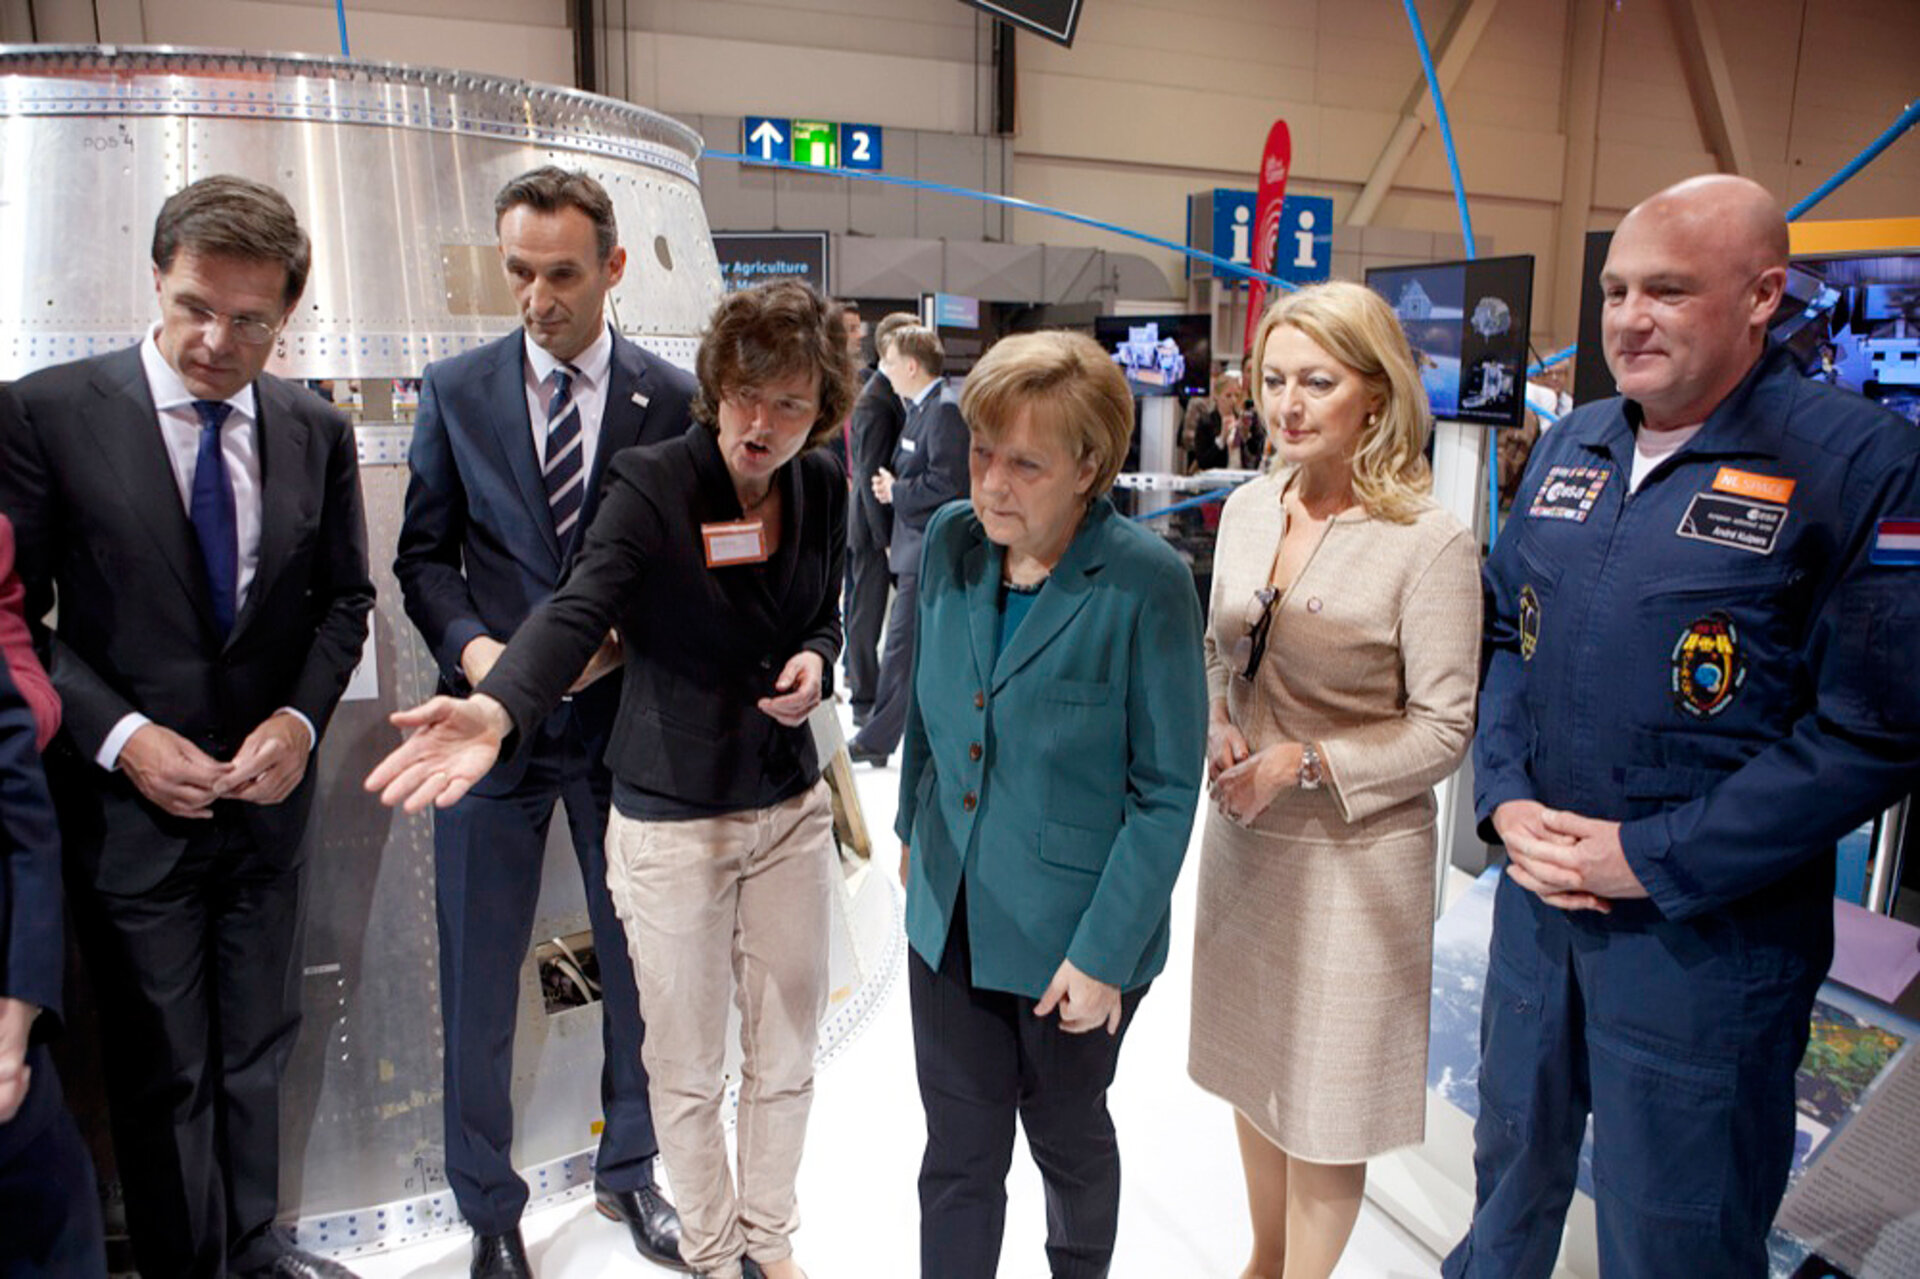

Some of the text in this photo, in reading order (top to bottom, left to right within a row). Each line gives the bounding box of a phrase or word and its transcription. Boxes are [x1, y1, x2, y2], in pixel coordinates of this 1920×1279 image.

[123, 132, 135, 154] 4
[852, 131, 870, 161] 2
[1293, 210, 1317, 268] i
[733, 260, 810, 277] Agriculture
[1720, 474, 1739, 489] NL
